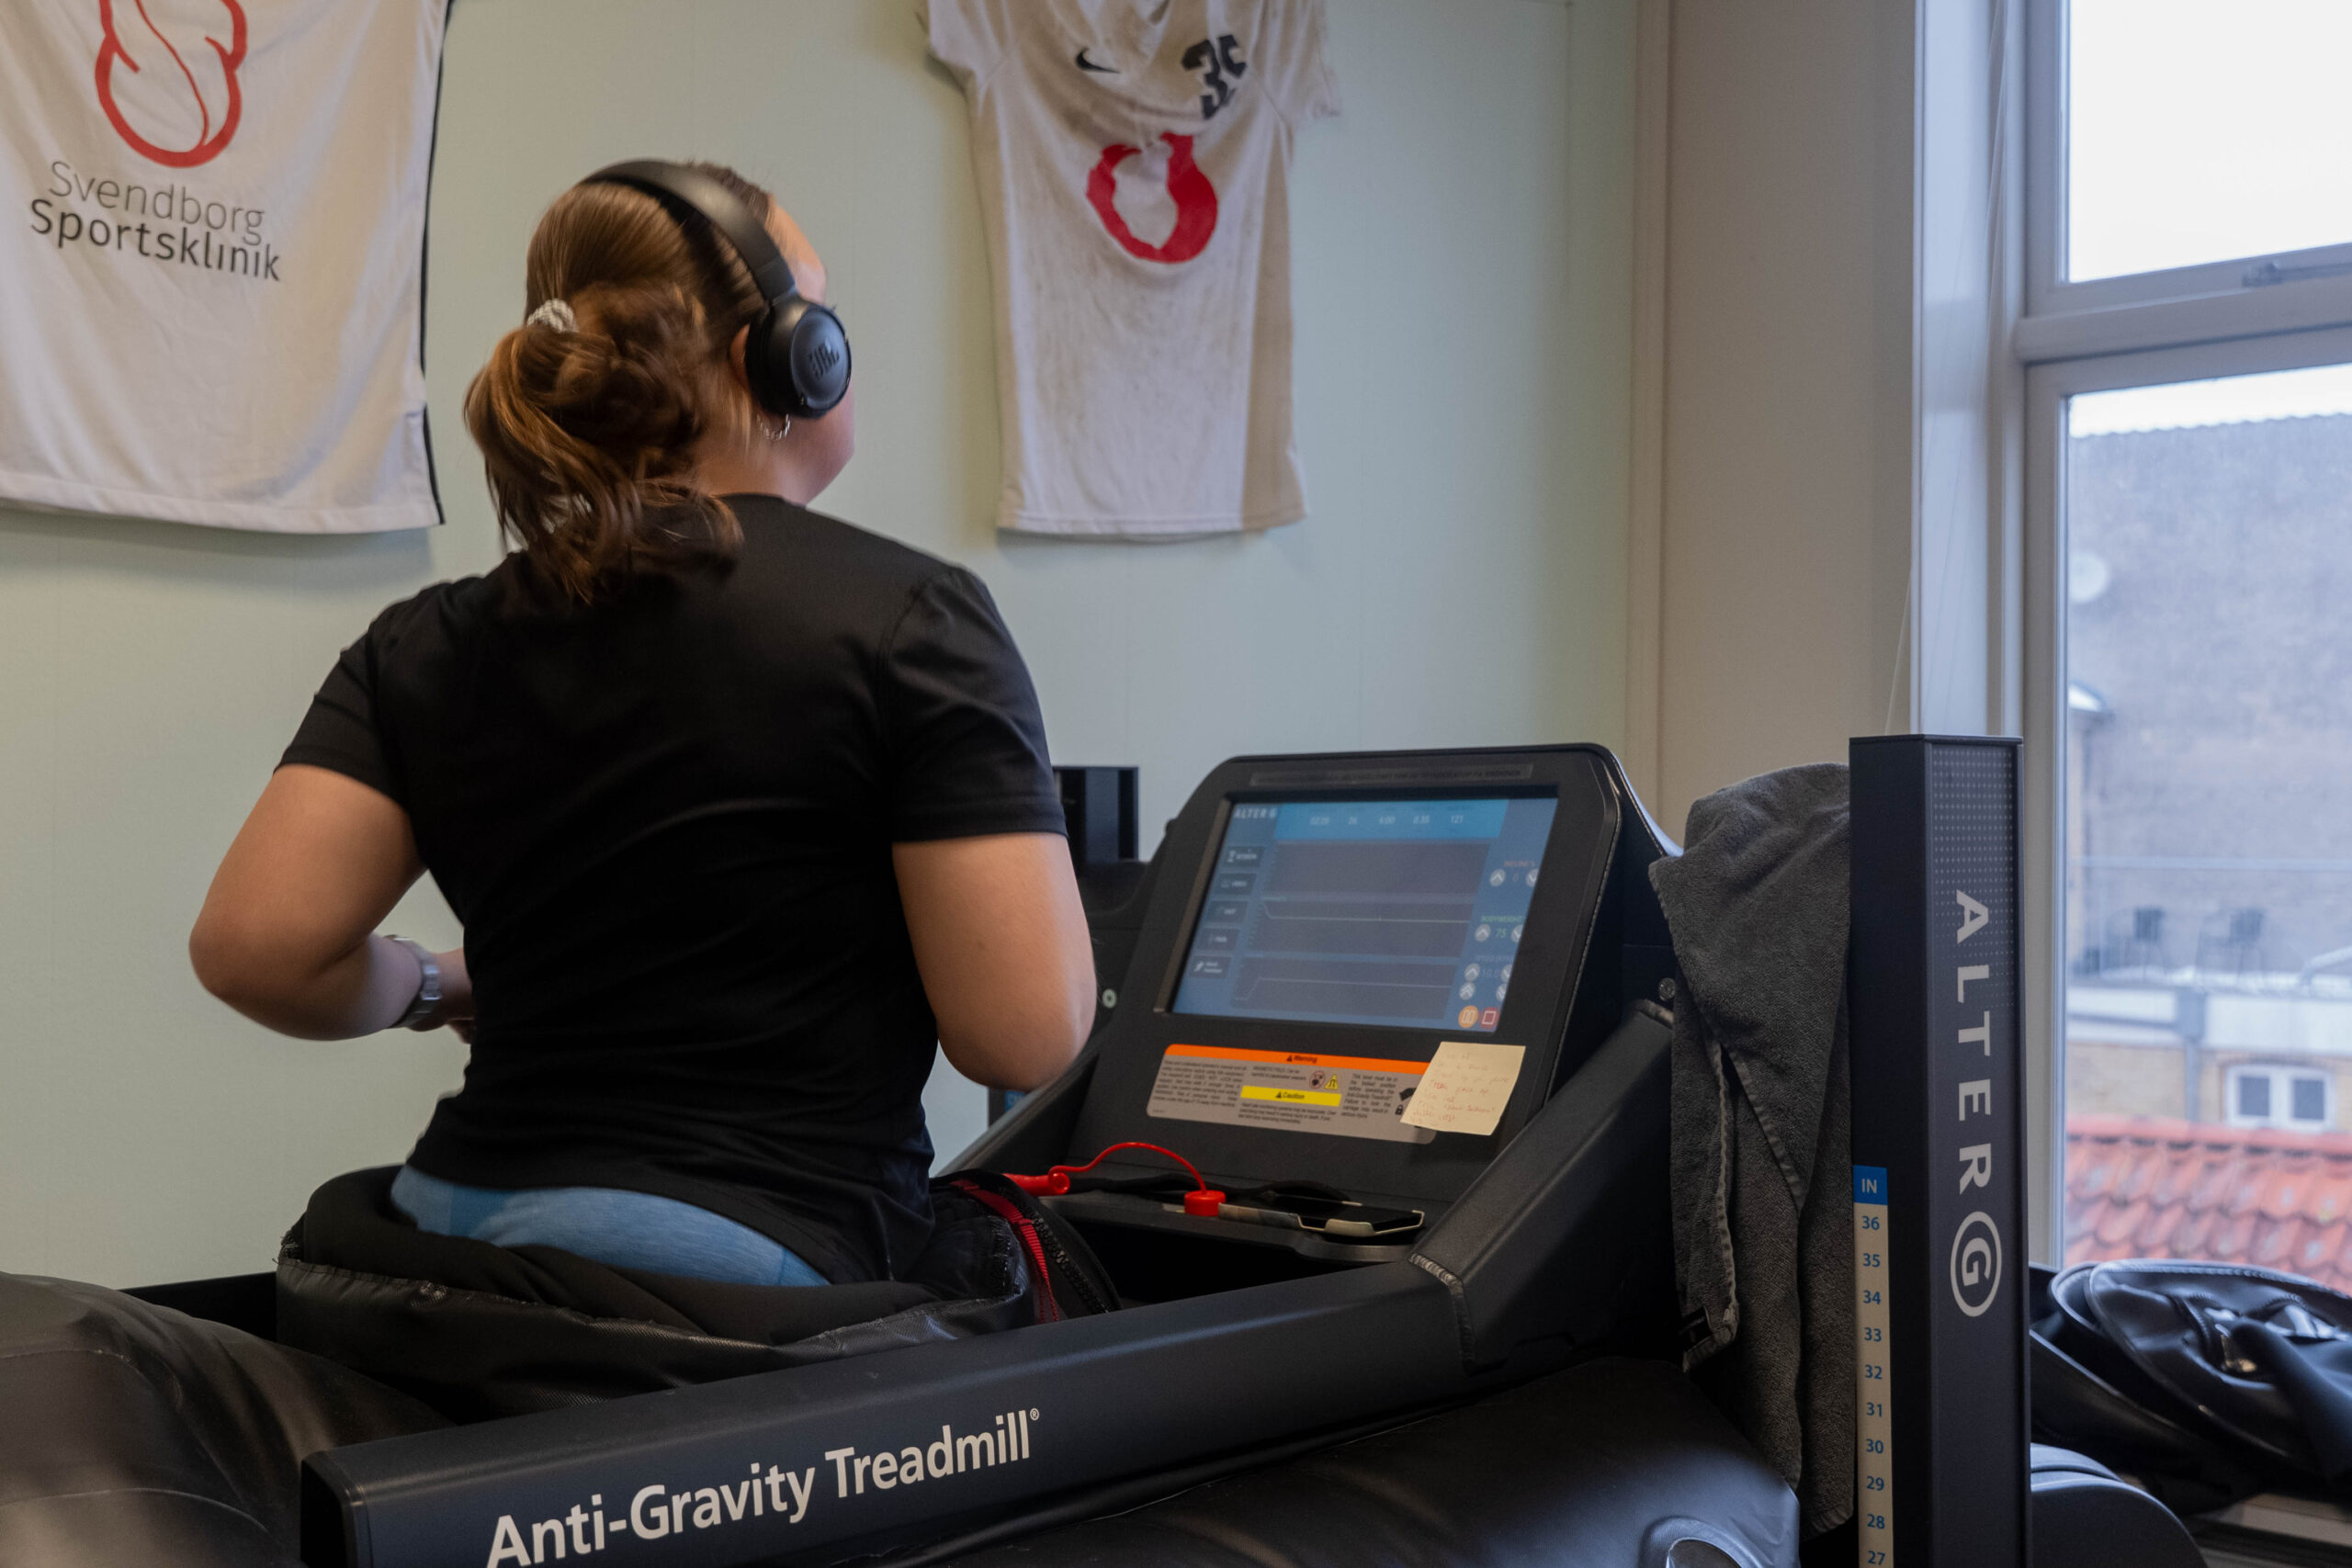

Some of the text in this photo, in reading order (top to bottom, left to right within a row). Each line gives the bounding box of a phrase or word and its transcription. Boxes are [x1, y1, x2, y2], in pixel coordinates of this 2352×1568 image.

[48, 161, 266, 246] Svendborg
[1861, 1178, 1878, 1194] IN
[1862, 1216, 1880, 1230] 36
[1863, 1253, 1880, 1268] 35
[1863, 1291, 1881, 1304] 34
[1864, 1327, 1882, 1342] 33
[1865, 1364, 1882, 1380] 32
[1867, 1403, 1882, 1416] 31
[1867, 1438, 1883, 1454] 30
[1867, 1476, 1884, 1491] 29
[486, 1462, 816, 1568] Anti-Gravity
[1867, 1514, 1884, 1529] 28
[1868, 1551, 1885, 1565] 27
